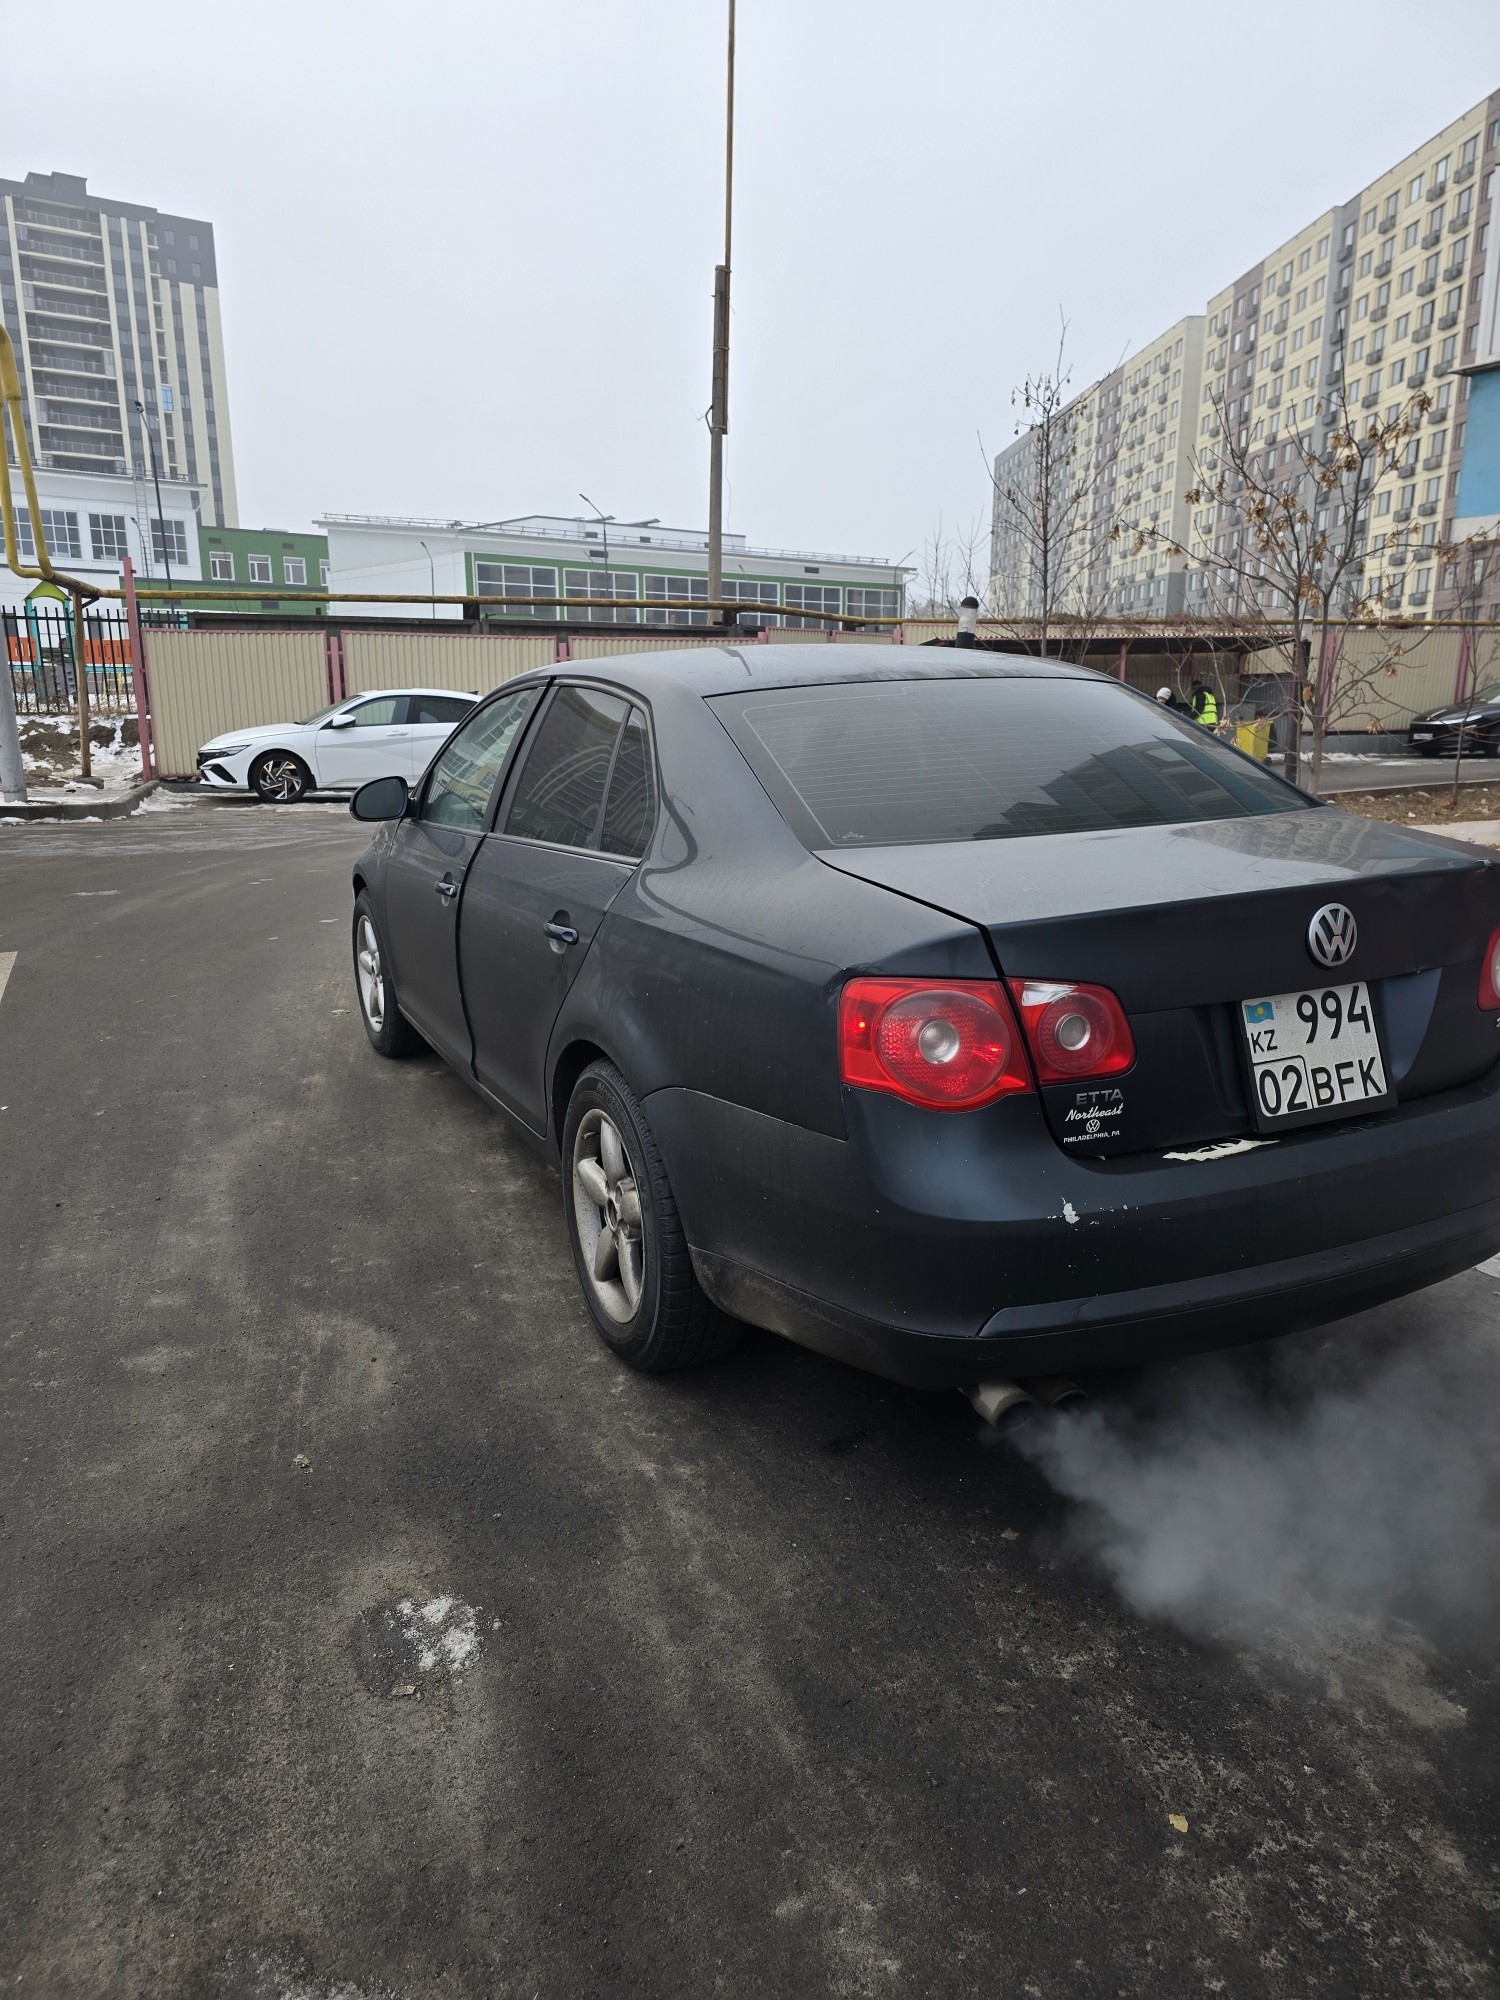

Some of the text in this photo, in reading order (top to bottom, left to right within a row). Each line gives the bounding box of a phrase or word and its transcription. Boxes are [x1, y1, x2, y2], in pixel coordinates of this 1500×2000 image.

[1309, 903, 1357, 966] VW
[1296, 985, 1371, 1044] 994
[1250, 1029, 1278, 1053] KZ
[1076, 1088, 1123, 1105] ETTA
[1259, 1057, 1382, 1115] 02 BFK
[1065, 1103, 1123, 1121] Northeast
